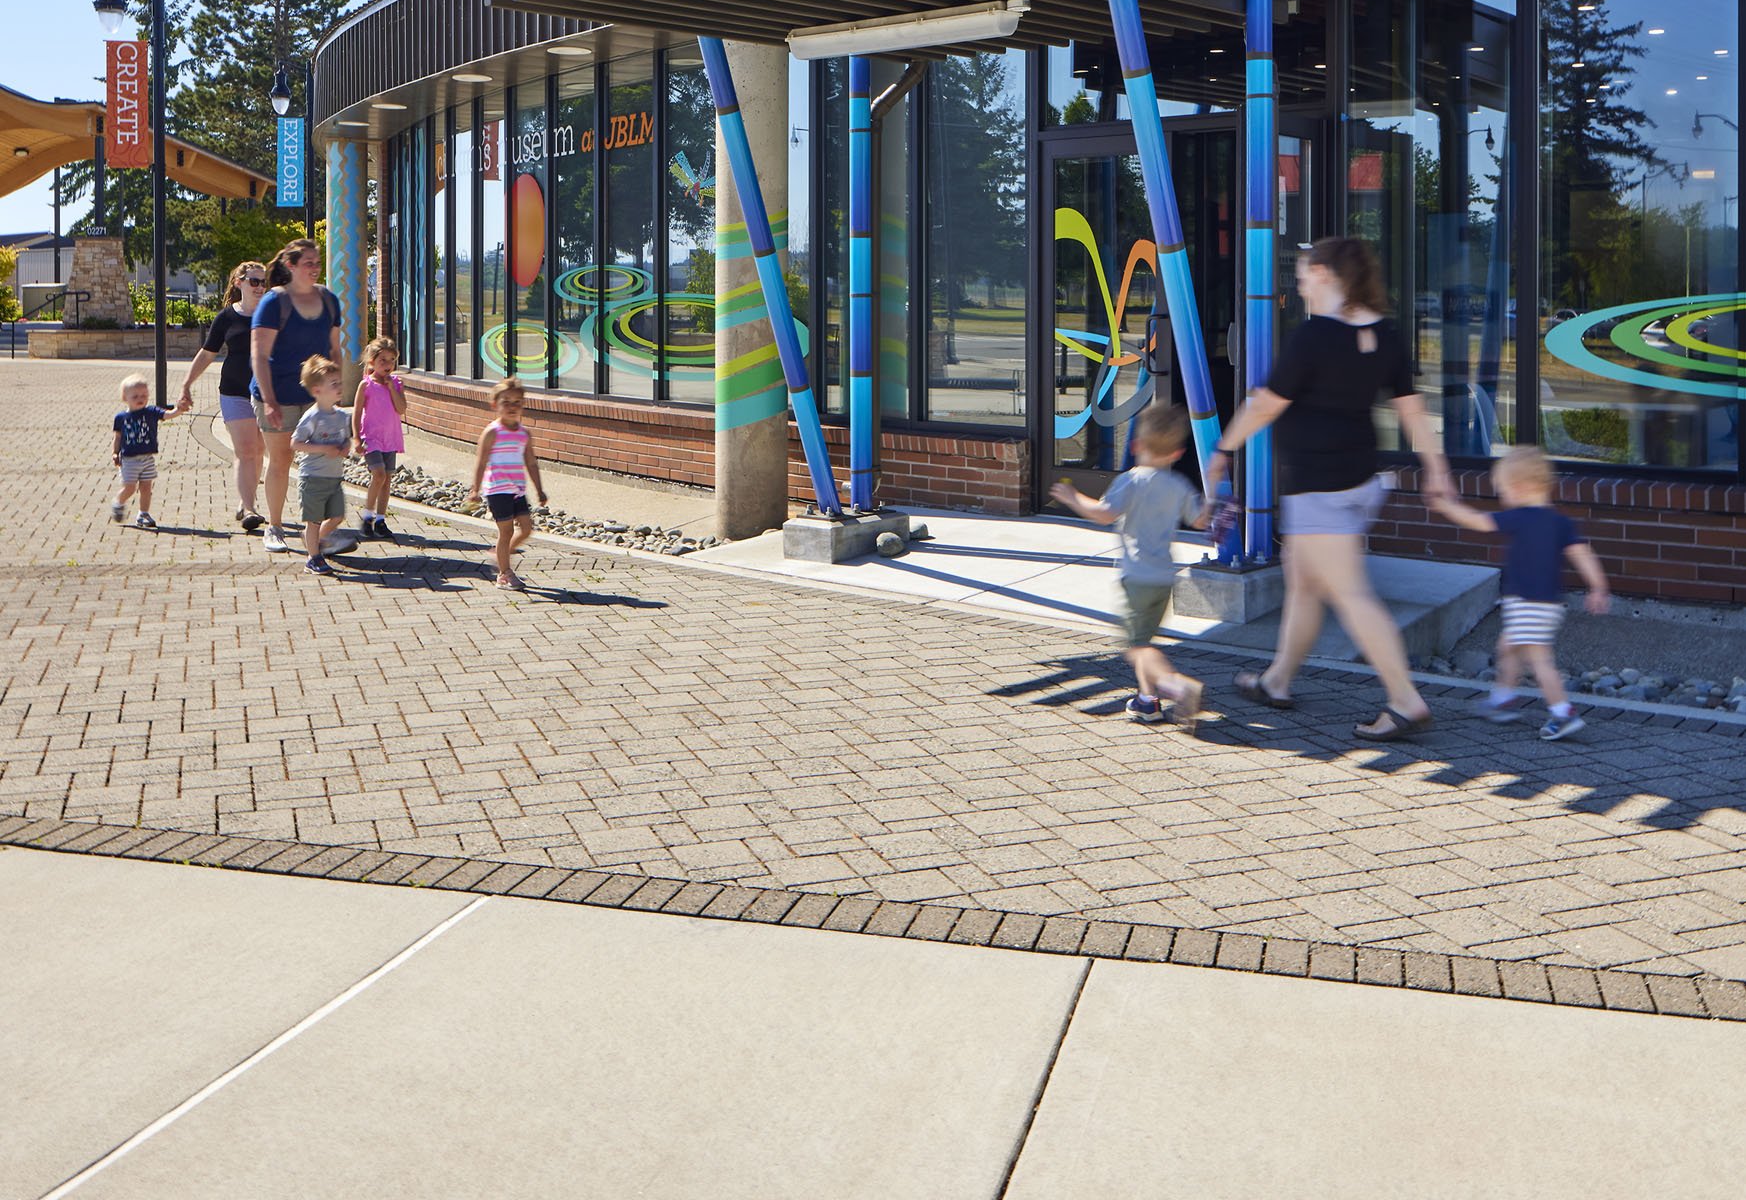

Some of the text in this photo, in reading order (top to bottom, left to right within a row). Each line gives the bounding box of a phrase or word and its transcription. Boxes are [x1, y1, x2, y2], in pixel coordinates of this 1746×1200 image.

[116, 42, 138, 145] CREATE
[283, 119, 298, 201] EXPLORE
[497, 124, 576, 167] usem
[604, 111, 655, 150] JBLM
[86, 226, 107, 236] 02271
